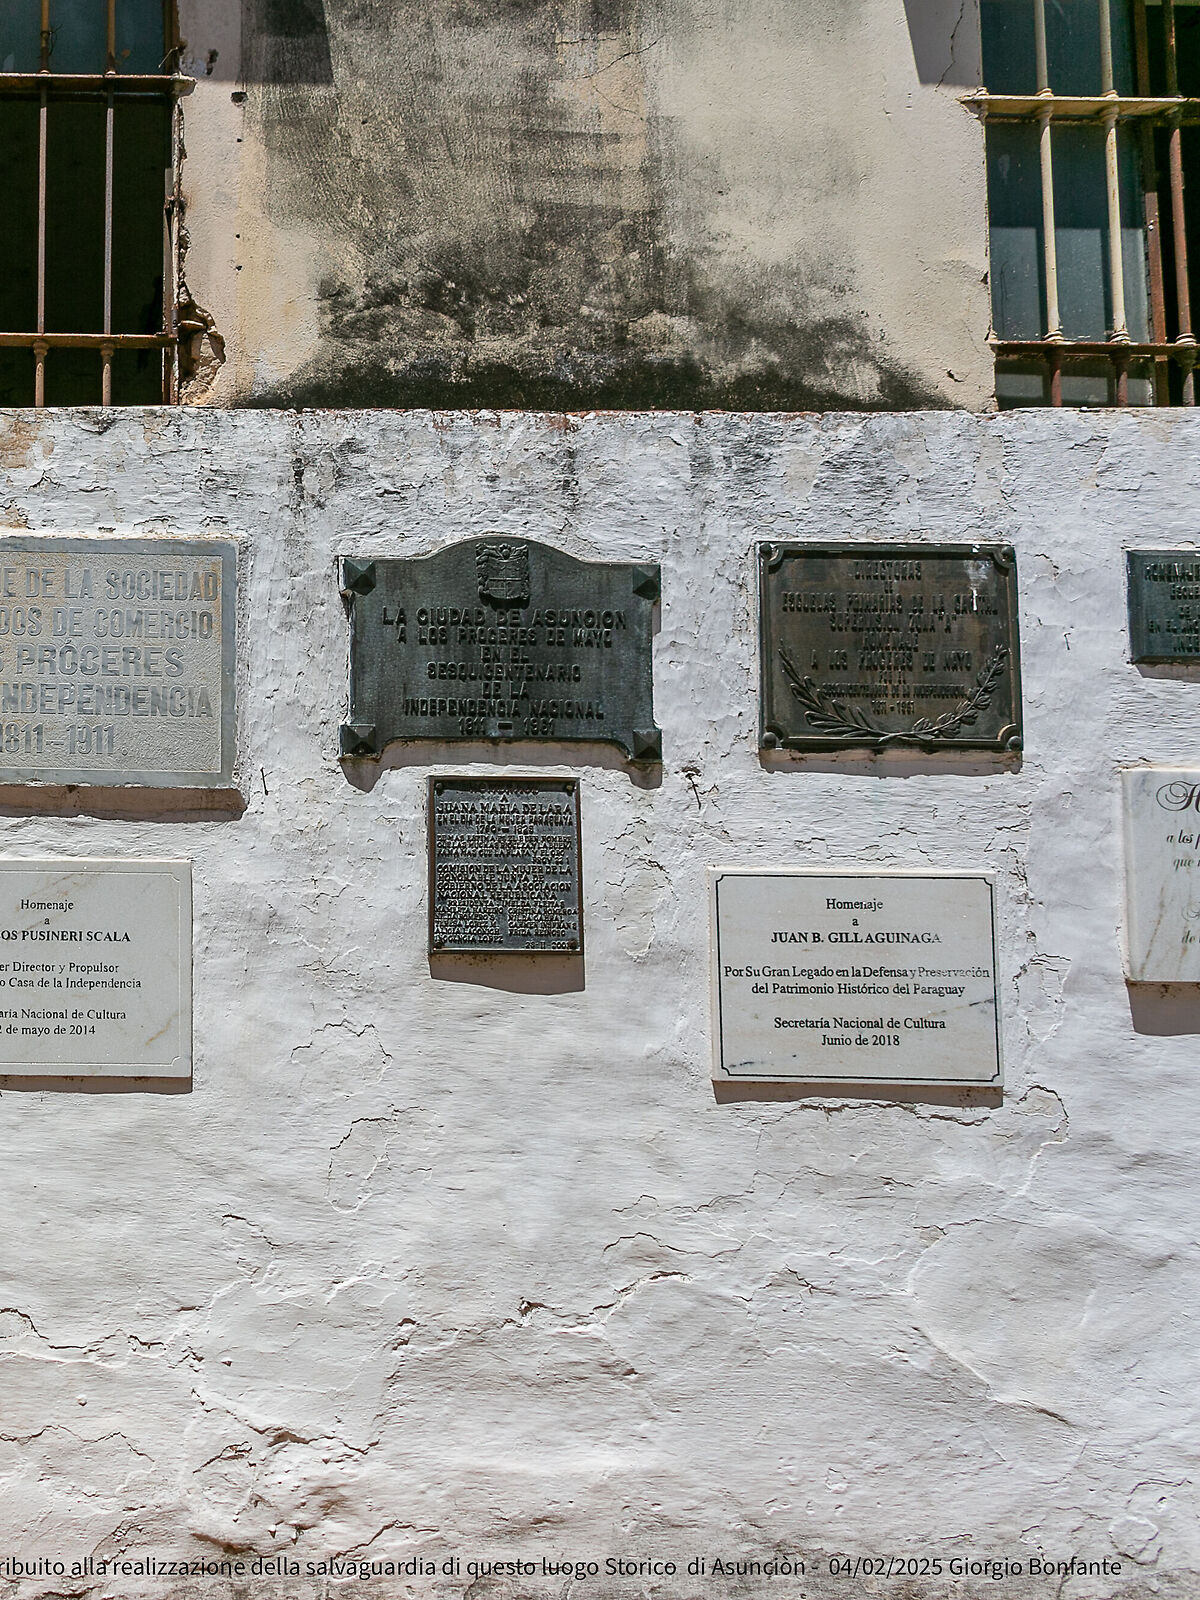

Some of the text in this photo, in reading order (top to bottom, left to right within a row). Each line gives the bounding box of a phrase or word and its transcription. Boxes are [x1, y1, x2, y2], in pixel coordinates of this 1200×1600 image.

[26, 567, 55, 599] DE
[64, 568, 93, 599] LA
[106, 569, 218, 601] SOCIEDAD
[53, 607, 82, 637] DE
[94, 608, 214, 640] COMERCIO
[383, 606, 627, 630] LA CIUDAD DE ASUNCION
[397, 626, 613, 648] A LOS PROCERES DE MAYO
[16, 640, 185, 678] PRÓCERES
[480, 645, 530, 664] EN EL
[427, 661, 581, 683] SESQUICENTENARIO
[482, 681, 529, 701] DE LA
[403, 698, 605, 720] INDEPENDENCIA NACIONAL
[522, 803, 538, 815] DE
[1166, 829, 1194, 844] a los
[1173, 858, 1194, 872] que
[20, 899, 75, 913] Homenaje
[825, 898, 884, 913] Homenaje
[43, 918, 51, 926] a
[852, 918, 860, 927] a
[21, 930, 84, 942] PUSINERI
[86, 931, 131, 943] SCALA
[770, 931, 942, 944] JUAN B. GILL AGUINAGA
[1181, 930, 1196, 944] de
[13, 961, 56, 973] Director
[58, 964, 66, 975] y
[68, 961, 120, 975] Propulsor
[723, 965, 990, 980] Por Su Gran Legado en la Defensa y Preservación
[8, 976, 35, 988] Casa
[37, 977, 51, 988] de
[53, 977, 63, 988] la
[66, 977, 142, 990] Independencia
[751, 982, 966, 998] del Patrimonio Histórico del Paraguay
[21, 1008, 68, 1019] Nacional
[71, 1009, 85, 1019] de
[87, 1009, 127, 1020] Cultura
[773, 1016, 947, 1030] Secretaría Nacional de Cultura
[5, 1024, 19, 1035] de
[21, 1026, 51, 1038] mayo
[53, 1025, 67, 1035] de
[69, 1025, 96, 1036] 2014
[820, 1034, 901, 1047] Junio de 2018
